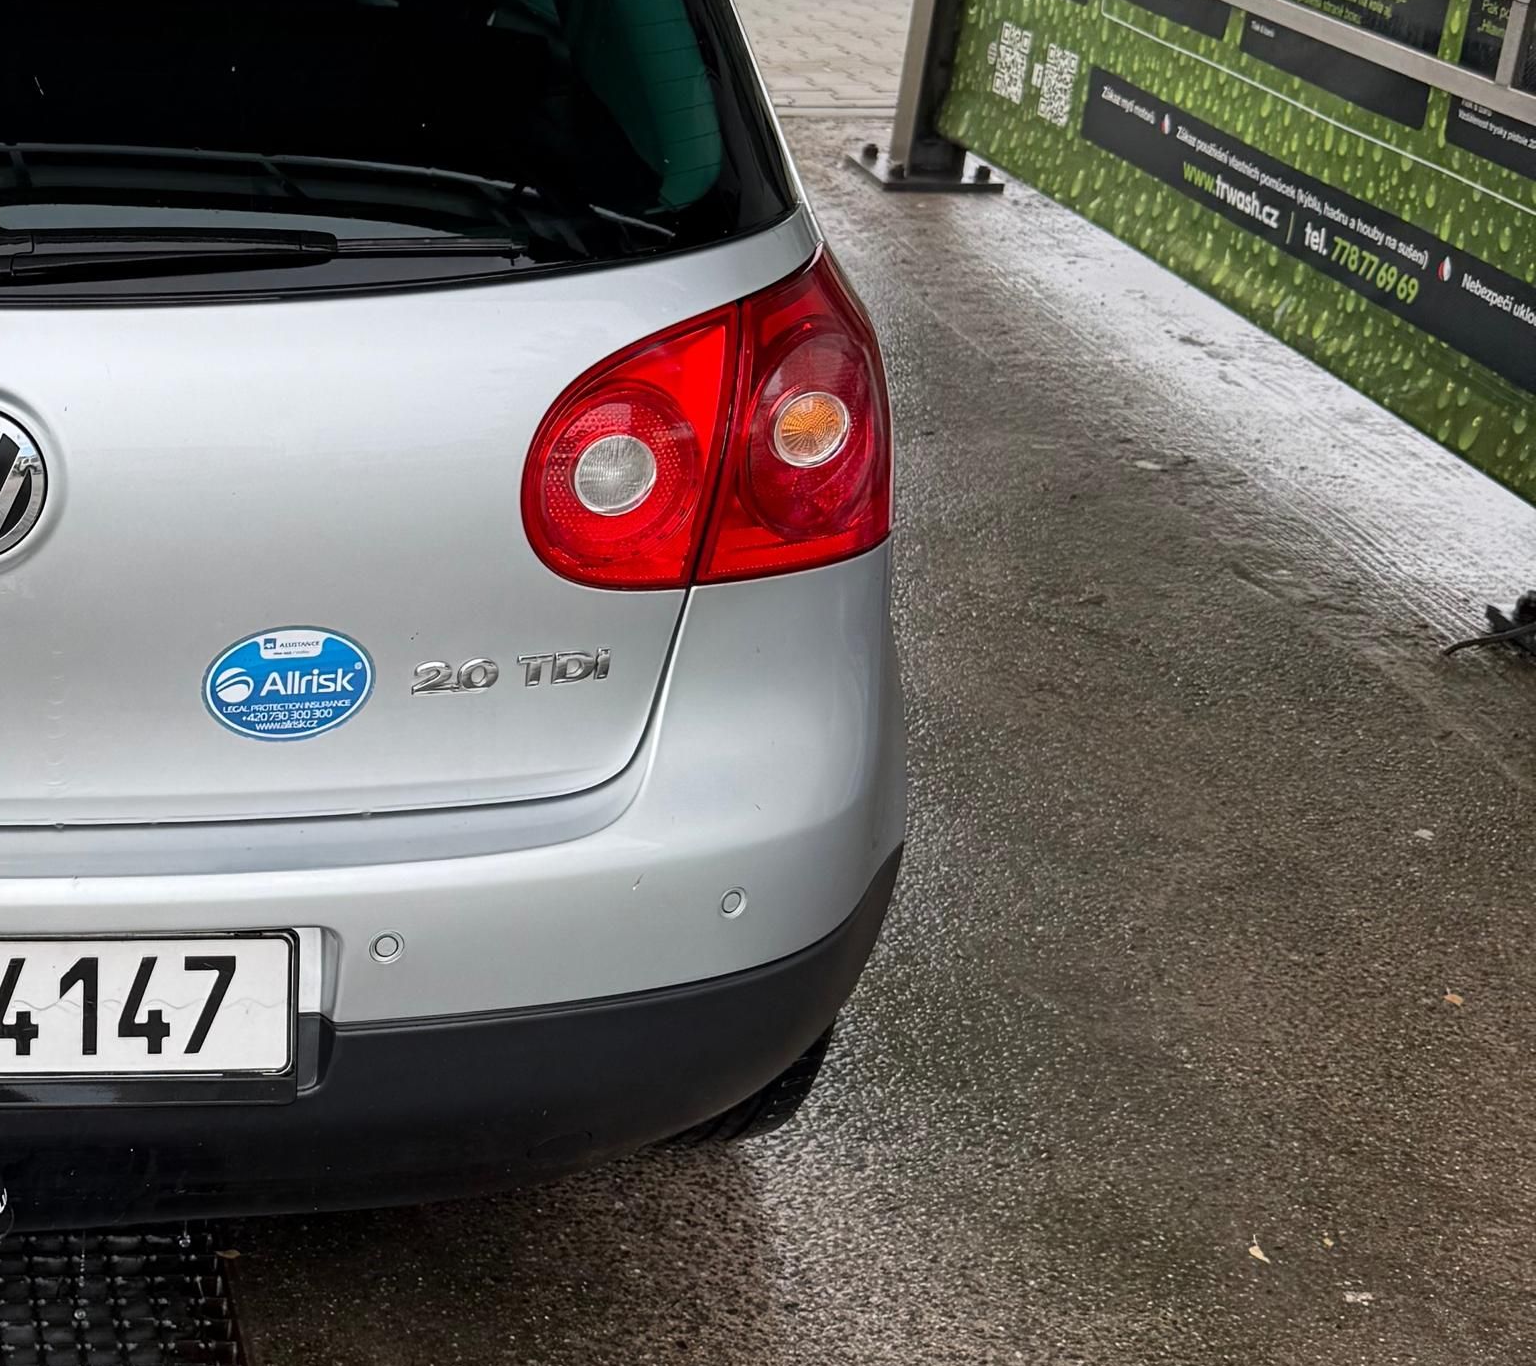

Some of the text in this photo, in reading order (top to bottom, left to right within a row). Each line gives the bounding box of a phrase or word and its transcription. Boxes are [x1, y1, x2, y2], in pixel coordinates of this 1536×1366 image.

[1304, 220, 1328, 257] tel.
[1323, 202, 1349, 226] hadru
[1356, 218, 1385, 247] houby
[1385, 233, 1397, 250] na
[1461, 272, 1514, 313] Nebezpečí
[259, 667, 355, 697] Allrisk
[410, 657, 500, 696] 2.0
[223, 699, 352, 714] LEGAL PROTECTION INSURANCE
[242, 708, 333, 722] +420 730 300 300
